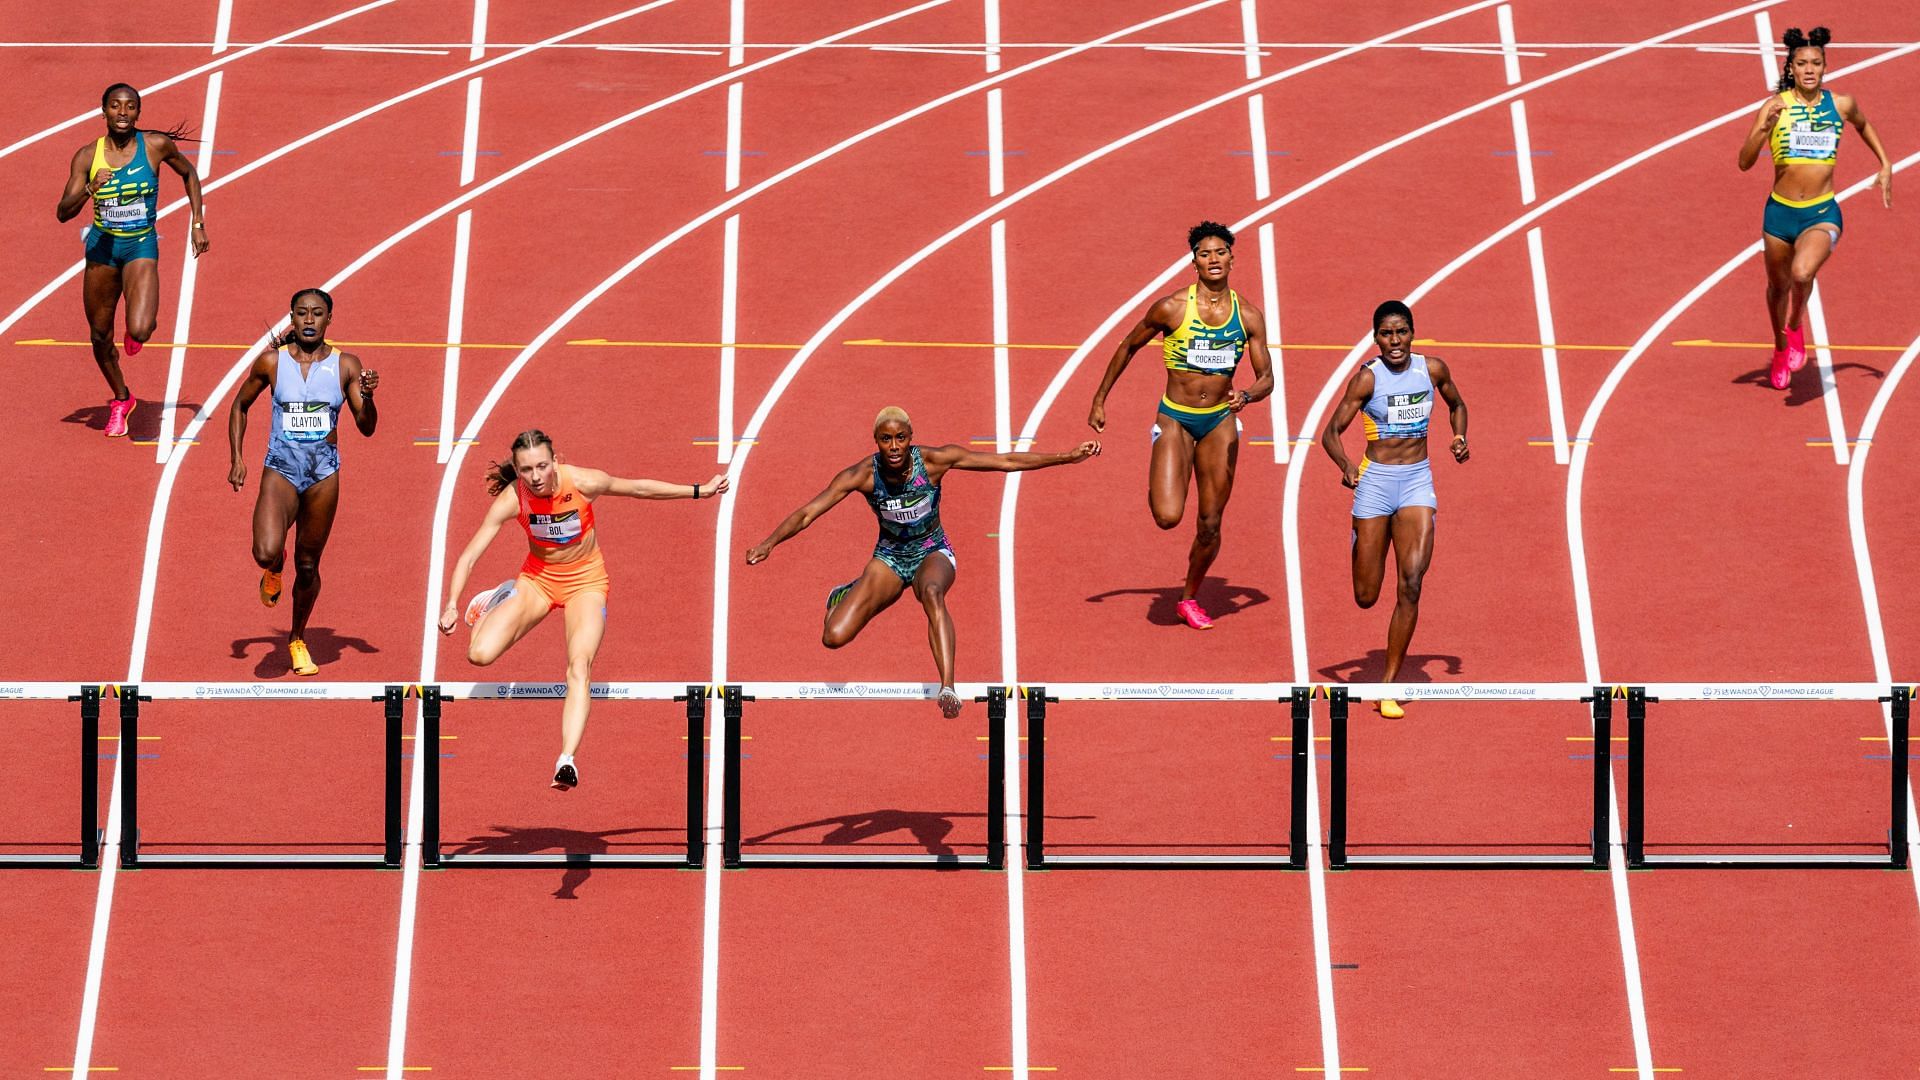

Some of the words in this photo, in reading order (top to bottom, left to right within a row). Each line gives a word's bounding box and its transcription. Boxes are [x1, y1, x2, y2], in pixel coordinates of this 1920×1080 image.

[1795, 135, 1830, 146] WOODRUFF
[105, 208, 141, 219] FOLORUNSO
[1194, 339, 1210, 350] PRE
[1195, 354, 1227, 364] COCKRELL
[1394, 395, 1409, 406] PRE
[288, 402, 304, 413] PRE
[1397, 406, 1425, 421] RUSSELL
[291, 416, 322, 428] CLAYTON
[886, 499, 902, 511] PRE
[536, 514, 552, 524] PRE
[895, 509, 919, 521] LITTLE
[548, 526, 564, 535] BOL
